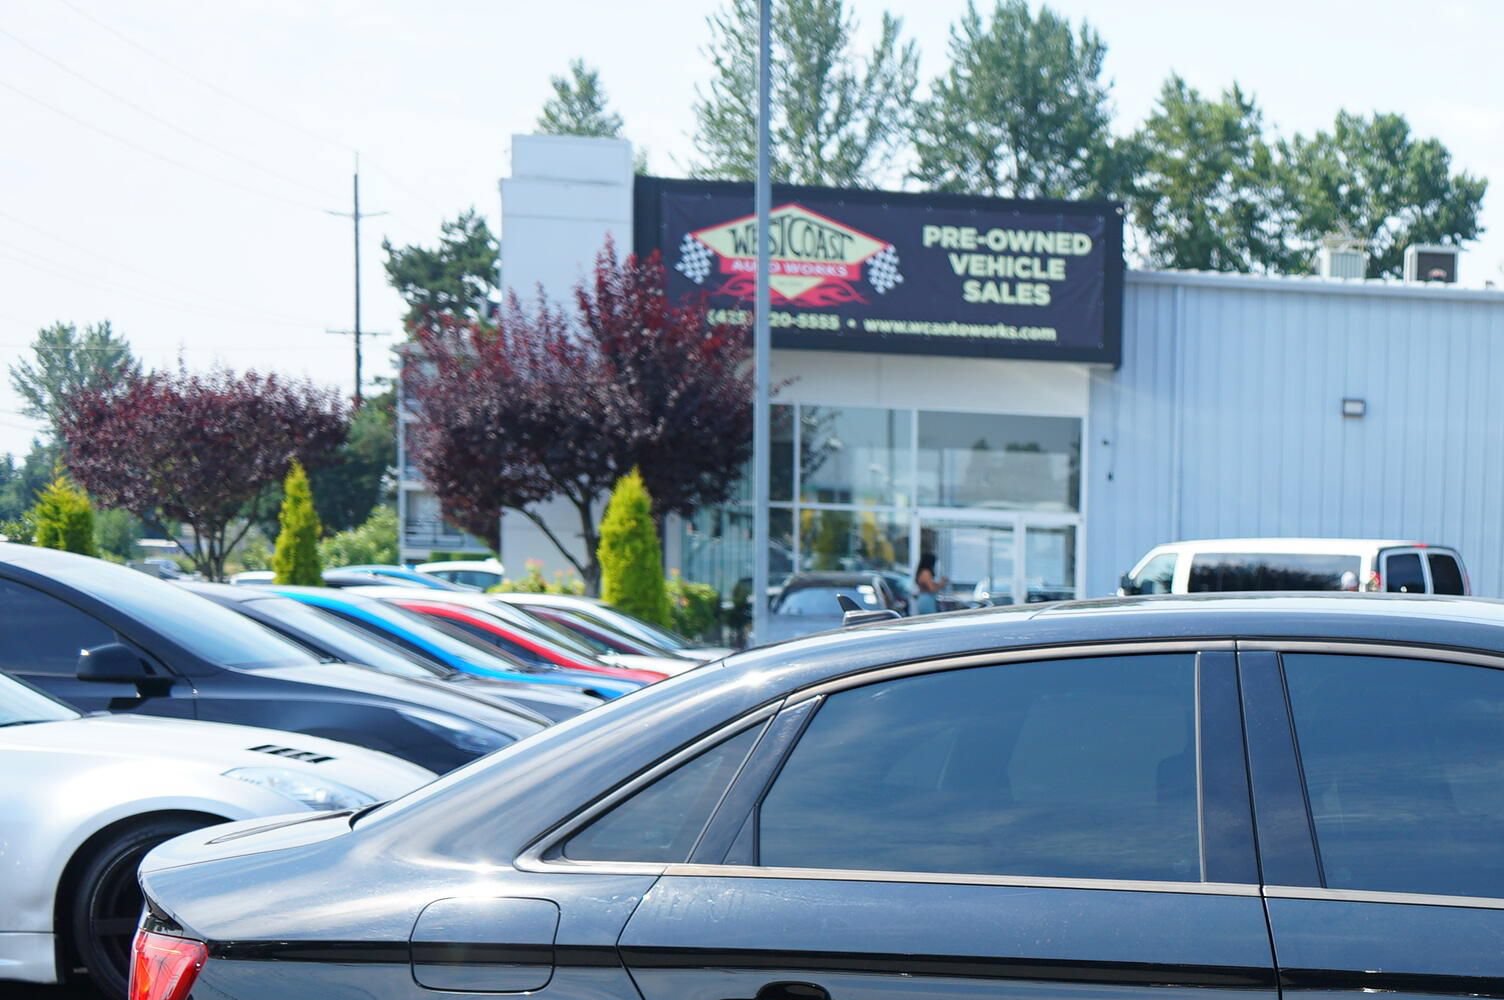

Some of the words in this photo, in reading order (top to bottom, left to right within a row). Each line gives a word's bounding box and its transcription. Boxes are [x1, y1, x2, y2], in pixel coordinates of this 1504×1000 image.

[922, 225, 1092, 256] PRE-OWNED
[731, 259, 780, 273] AUO
[784, 261, 848, 276] WORKS
[948, 252, 1066, 281] VEHICLE
[963, 280, 1051, 306] SALES
